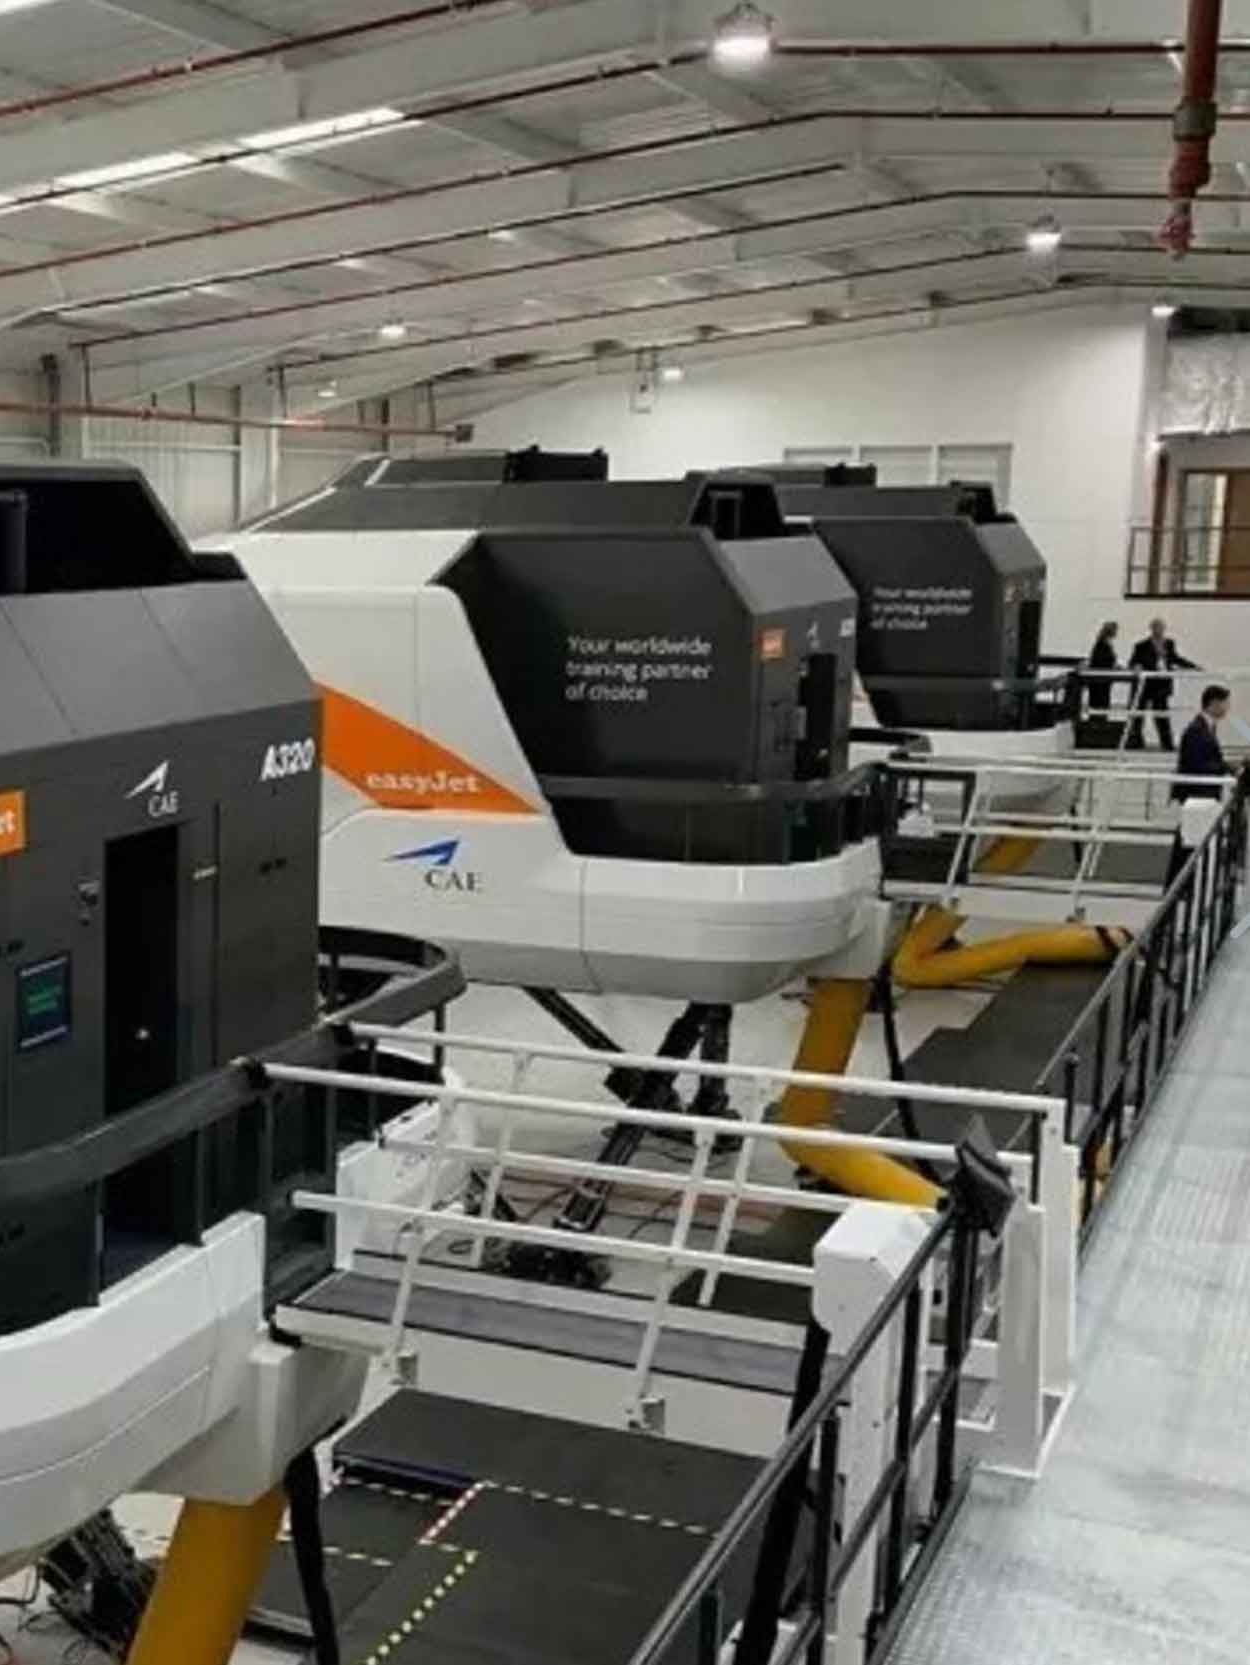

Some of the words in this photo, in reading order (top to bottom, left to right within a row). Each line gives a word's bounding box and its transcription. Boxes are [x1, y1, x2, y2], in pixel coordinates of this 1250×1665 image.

[567, 634, 611, 655] Your
[614, 635, 712, 656] worldwide
[565, 660, 638, 682] training
[641, 663, 713, 682] partner
[565, 681, 587, 700] of
[588, 683, 648, 701] choice
[260, 738, 315, 782] A320
[367, 769, 479, 796] easyJet
[147, 790, 179, 818] CAE
[424, 869, 487, 892] CAE
